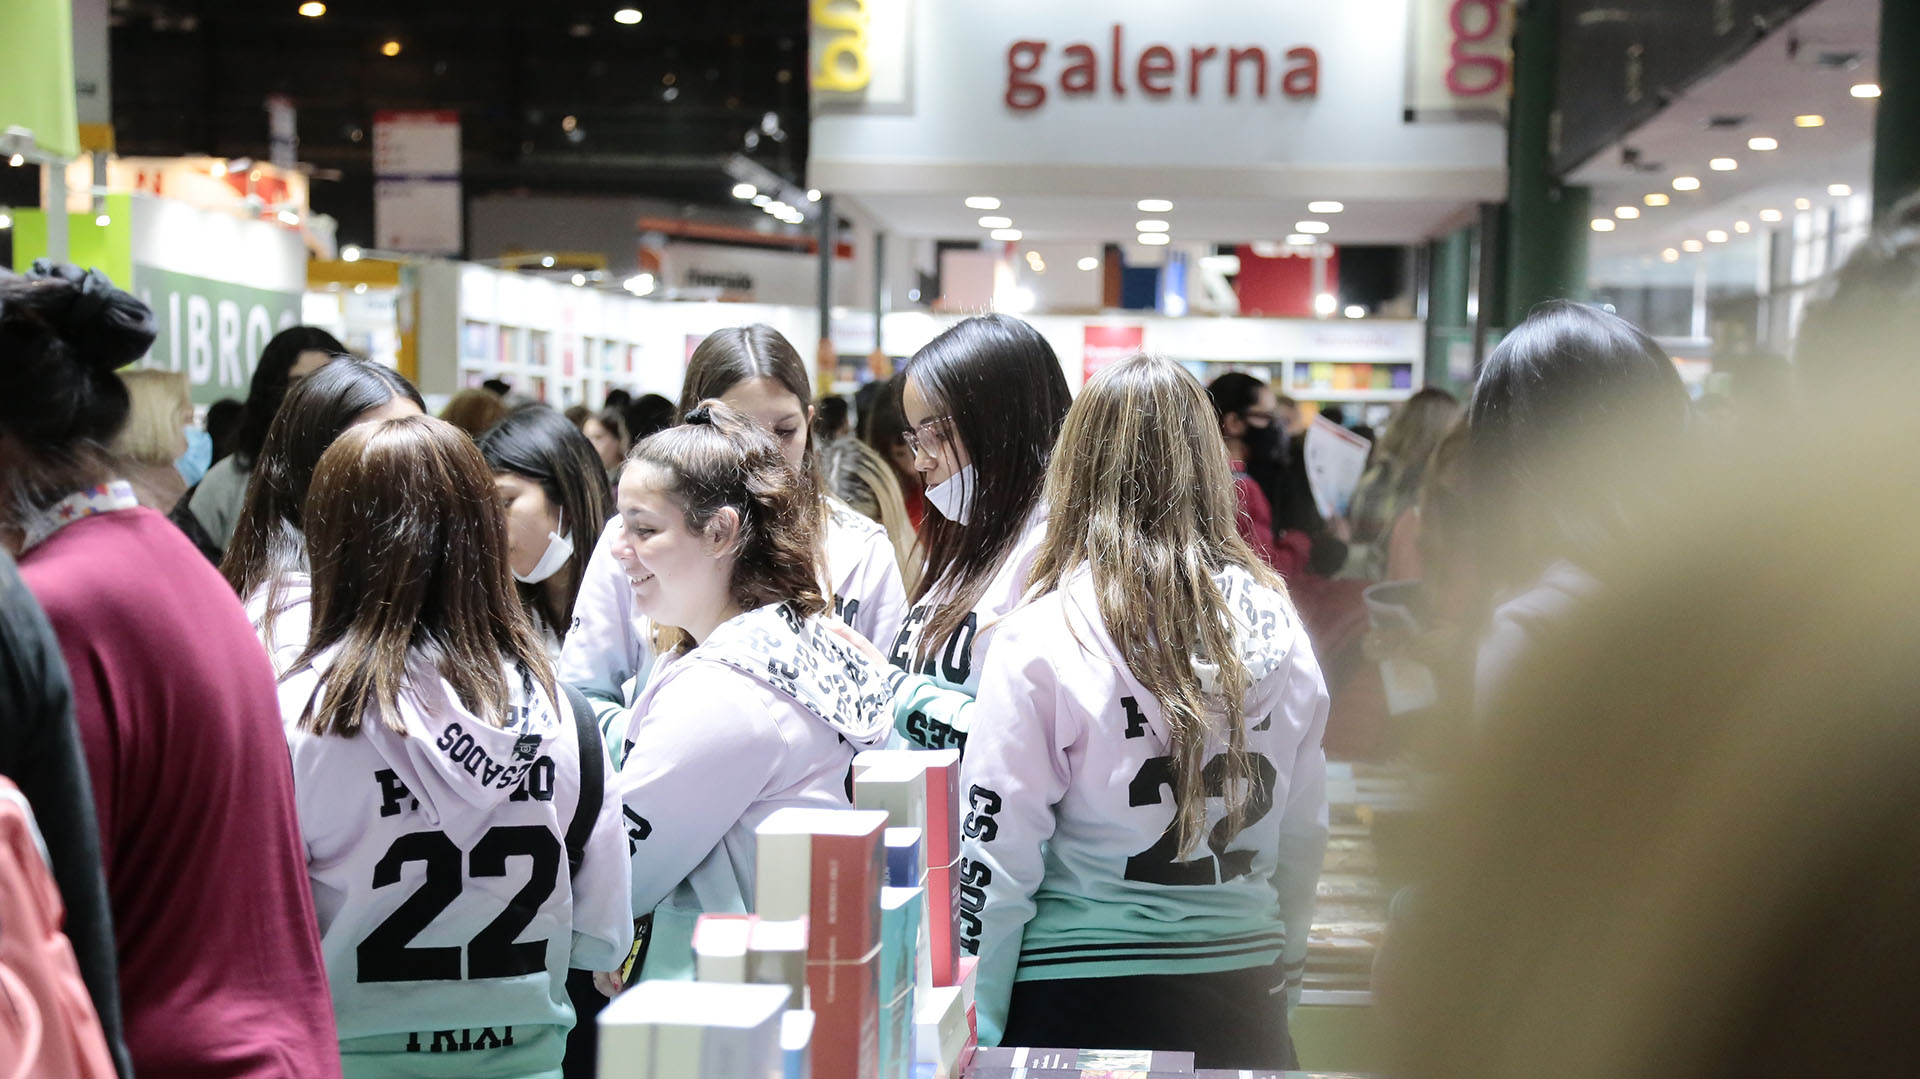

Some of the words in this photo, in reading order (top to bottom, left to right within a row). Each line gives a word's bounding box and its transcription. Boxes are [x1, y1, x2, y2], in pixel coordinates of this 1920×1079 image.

[1005, 24, 1320, 110] galerna
[141, 288, 297, 388] LIBRO
[1124, 752, 1277, 886] 22
[356, 825, 561, 982] 22
